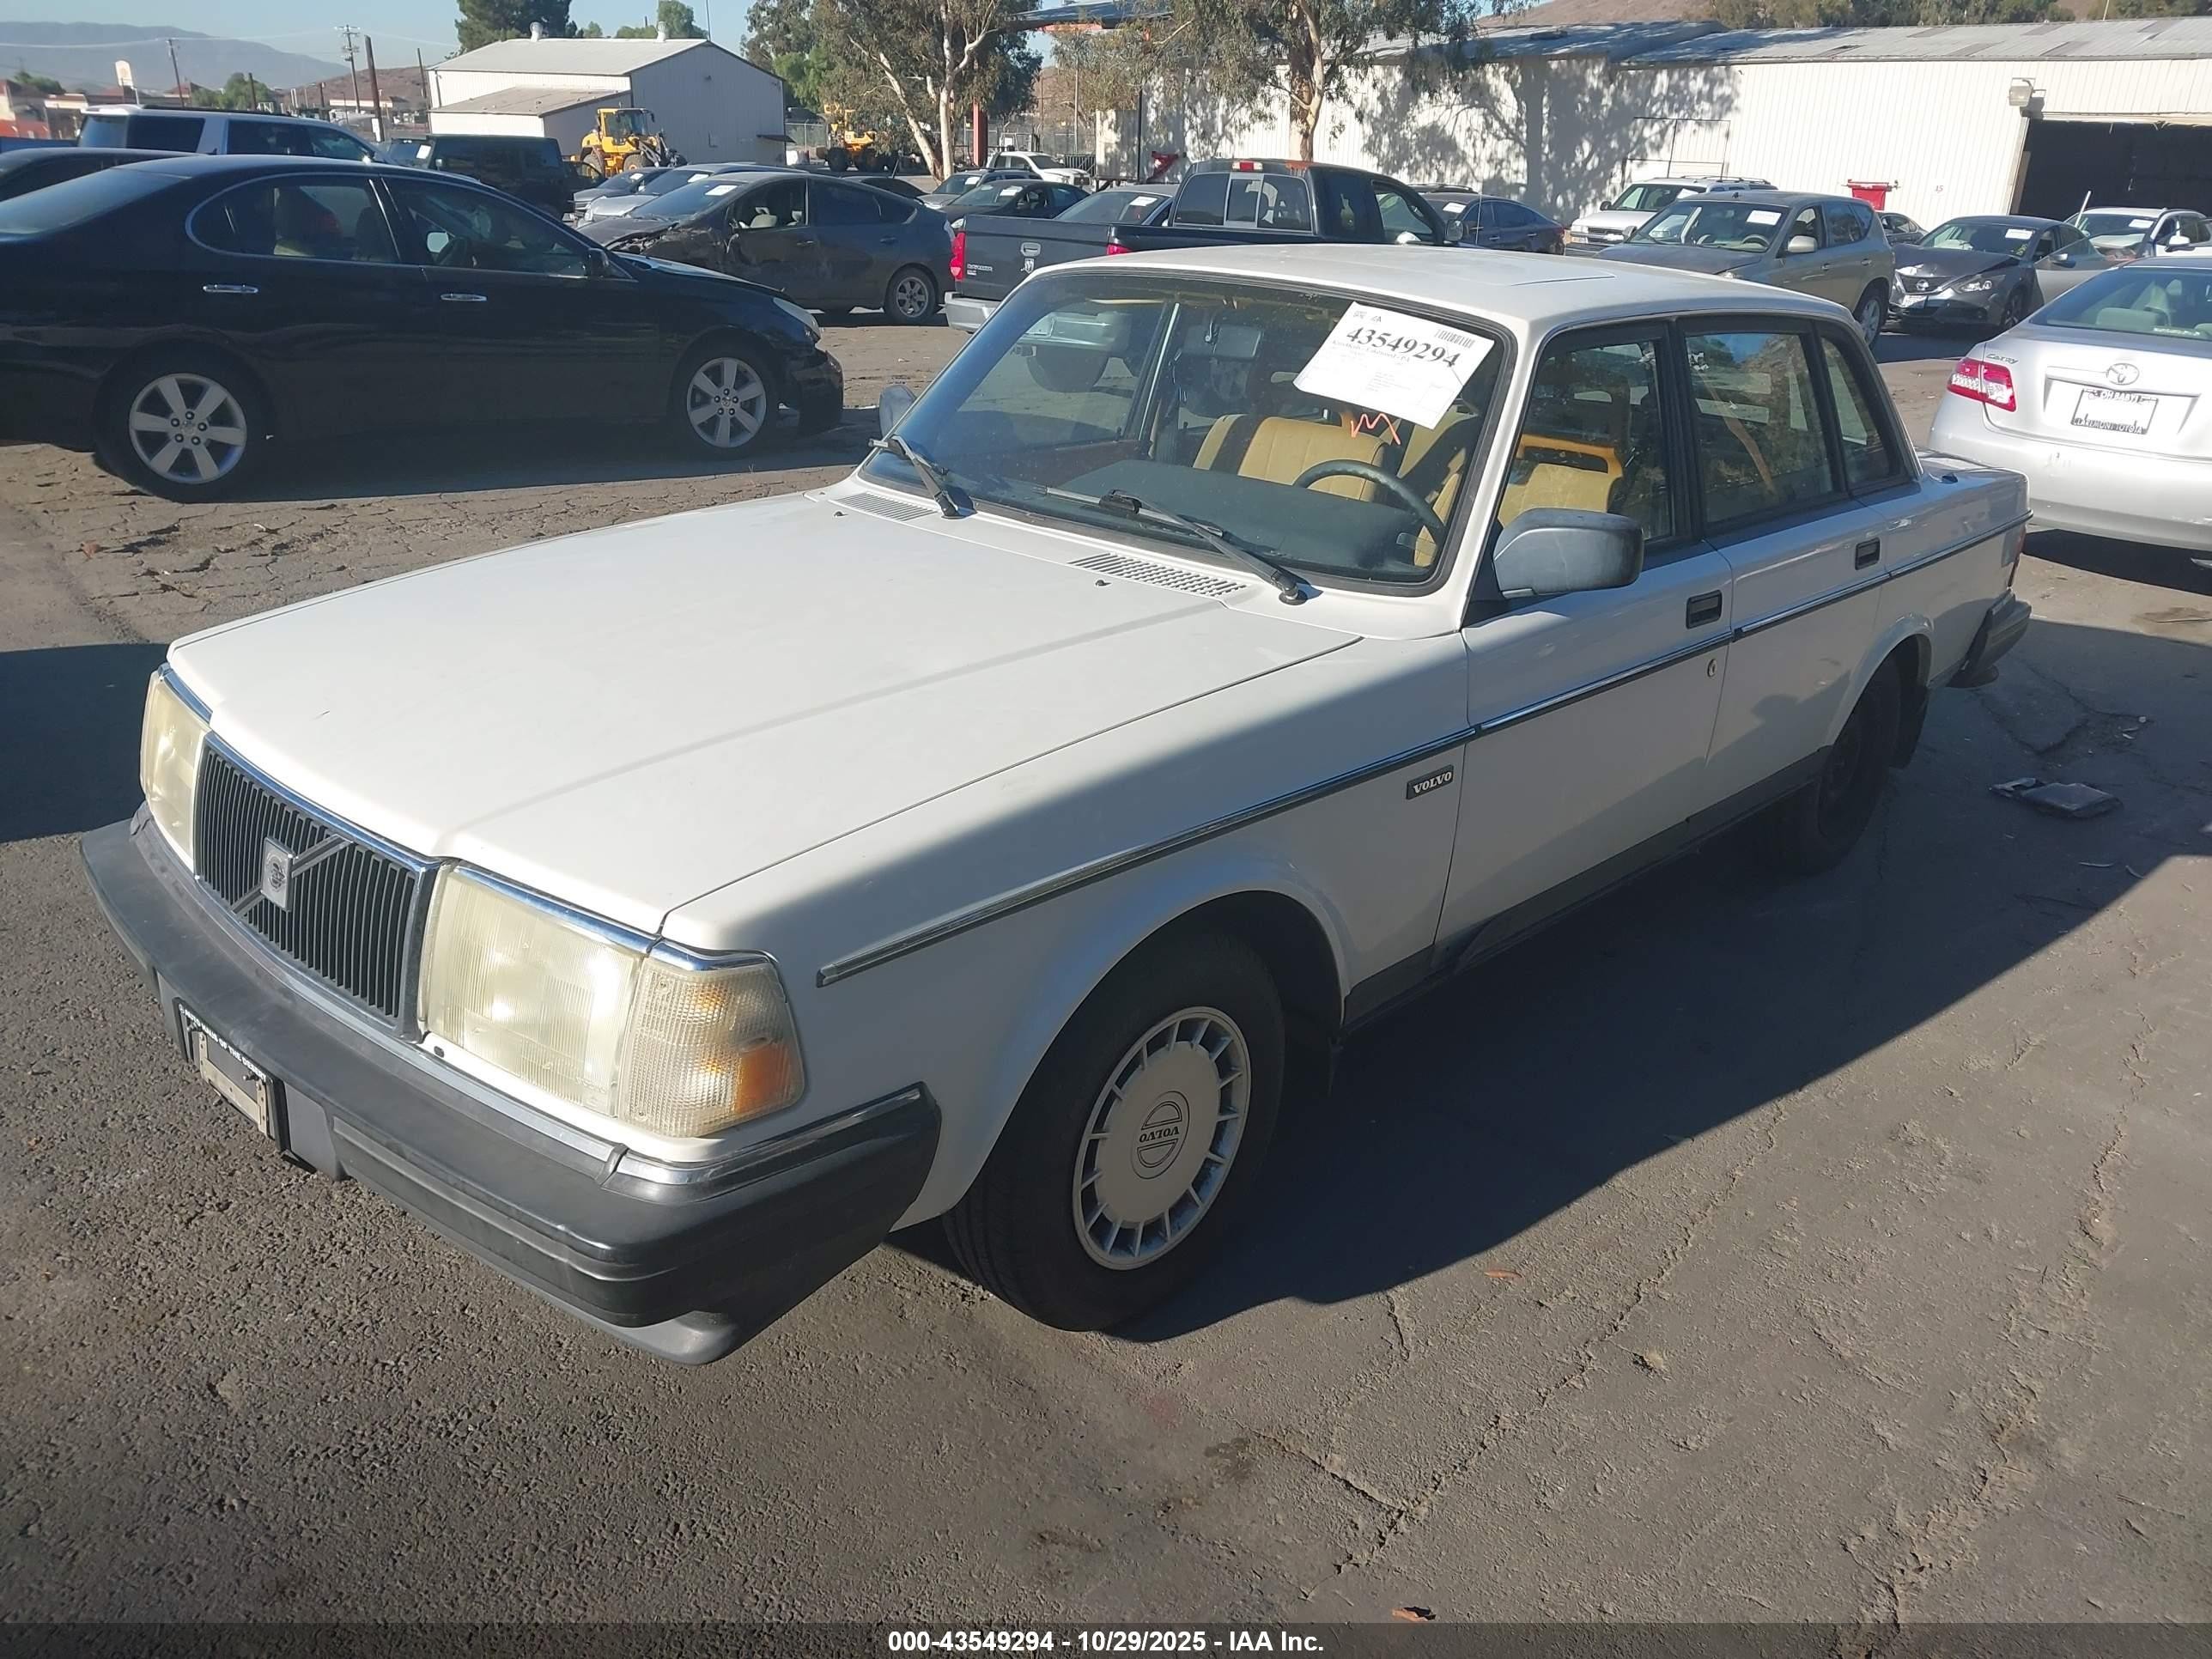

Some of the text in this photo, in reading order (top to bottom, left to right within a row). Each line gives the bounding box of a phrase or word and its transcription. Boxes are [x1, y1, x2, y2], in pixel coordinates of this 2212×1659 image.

[1346, 327, 1461, 368] 43549294
[1413, 771, 1452, 793] VOLVO
[1139, 1126, 1180, 1143] VOLVO
